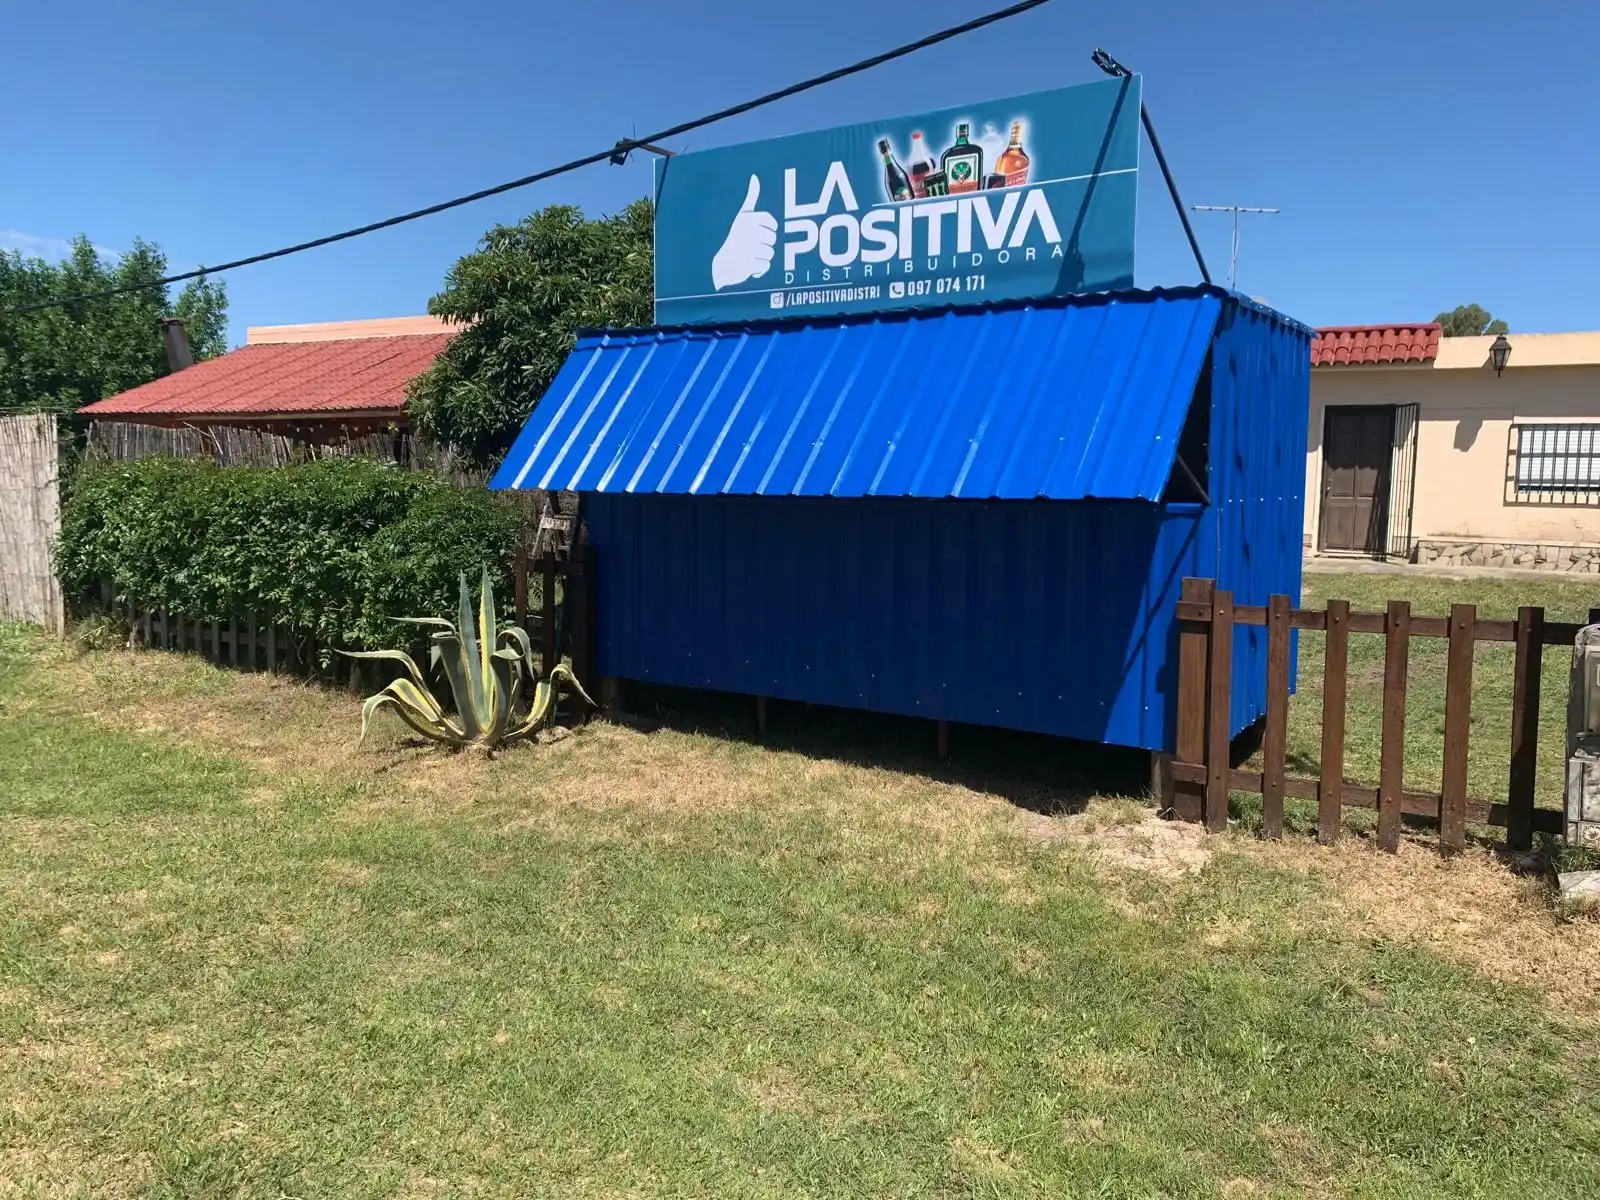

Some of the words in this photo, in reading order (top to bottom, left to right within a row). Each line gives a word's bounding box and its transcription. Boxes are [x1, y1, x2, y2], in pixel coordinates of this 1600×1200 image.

[785, 160, 859, 219] LA
[784, 188, 1063, 271] POSITIVA
[784, 243, 1064, 284] DISTRIBUIDORA
[785, 286, 880, 307] /LAPOSITIVADISTRI
[907, 279, 932, 298] 097
[936, 277, 961, 295] 074
[966, 275, 985, 293] 171
